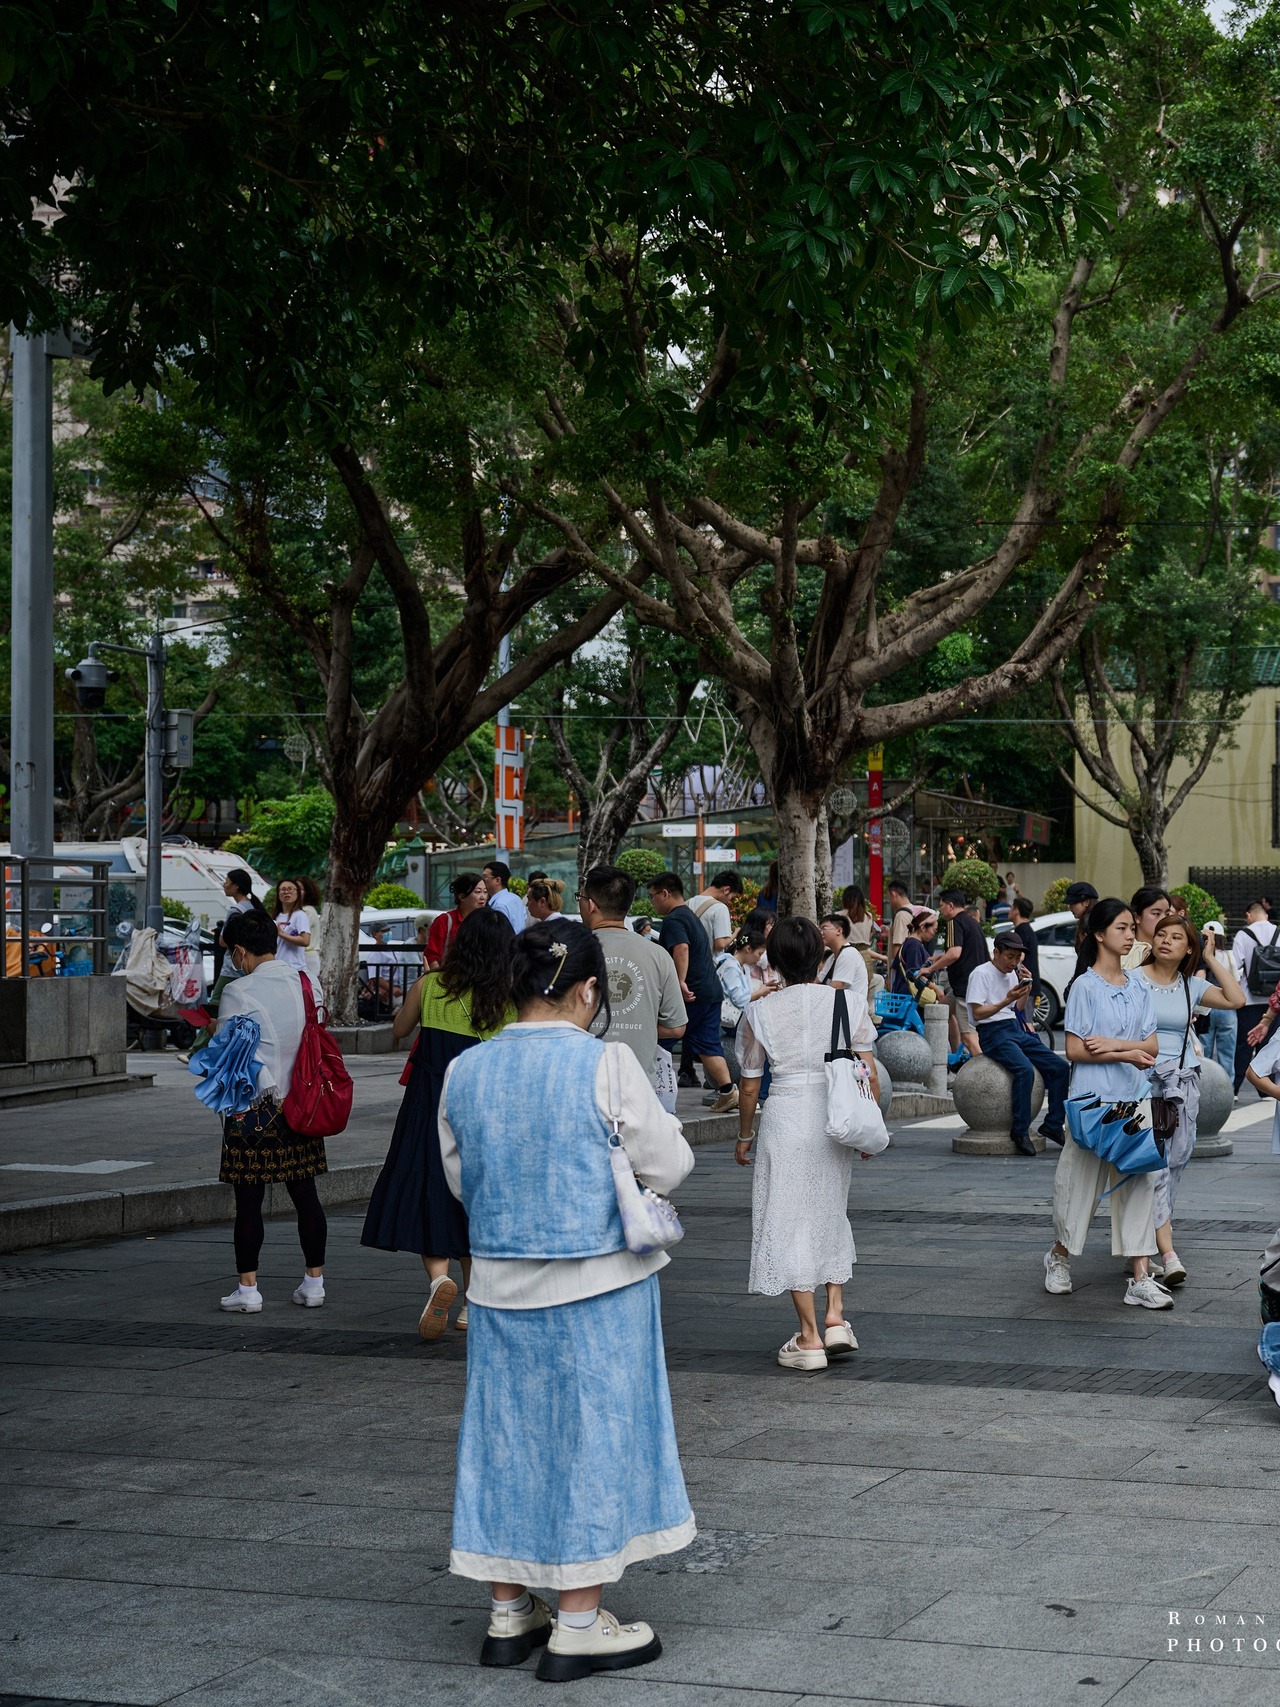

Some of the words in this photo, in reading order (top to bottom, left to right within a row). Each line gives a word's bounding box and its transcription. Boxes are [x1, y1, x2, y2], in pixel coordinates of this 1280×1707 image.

[605, 956, 625, 964] CITY
[627, 960, 644, 982] WALK
[622, 993, 643, 1015] ENOUGH
